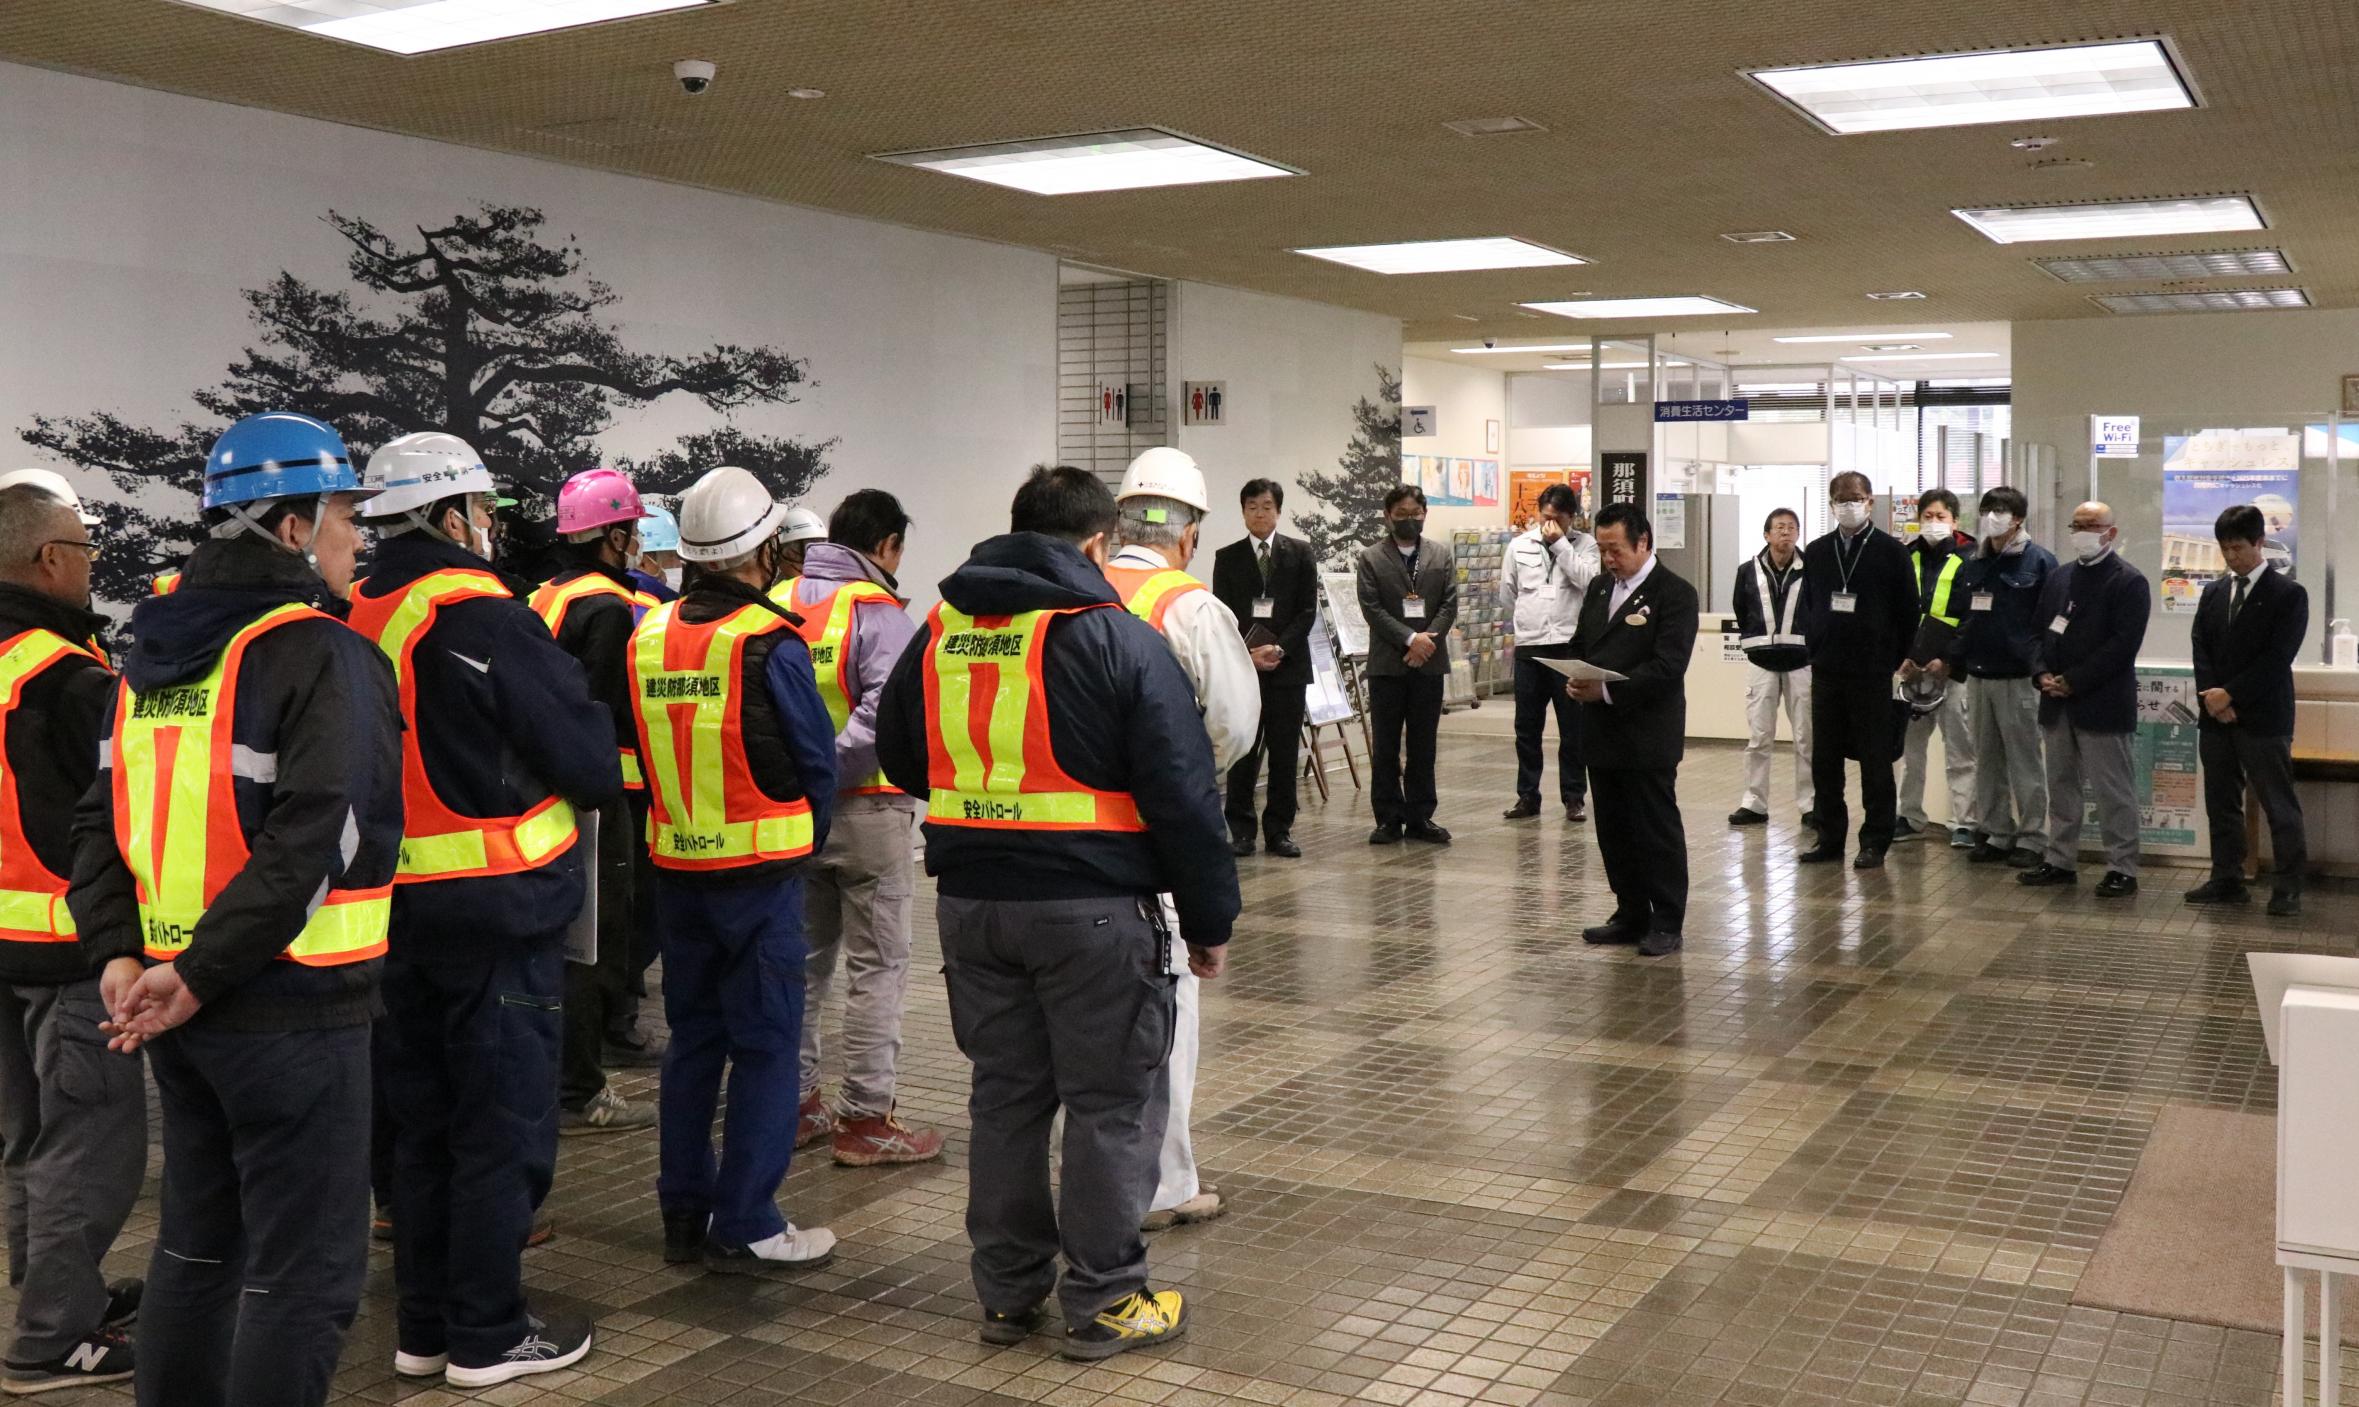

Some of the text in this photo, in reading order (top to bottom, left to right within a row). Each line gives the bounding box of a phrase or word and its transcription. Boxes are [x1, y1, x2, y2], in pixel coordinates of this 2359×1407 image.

[1660, 404, 1745, 418] 消費生活センター
[2103, 422, 2132, 432] Free
[2103, 433, 2132, 442] Wi-Fi
[963, 799, 1022, 821] 安全パトロール
[673, 831, 725, 852] 安全パトロール
[64, 1342, 109, 1372] N
